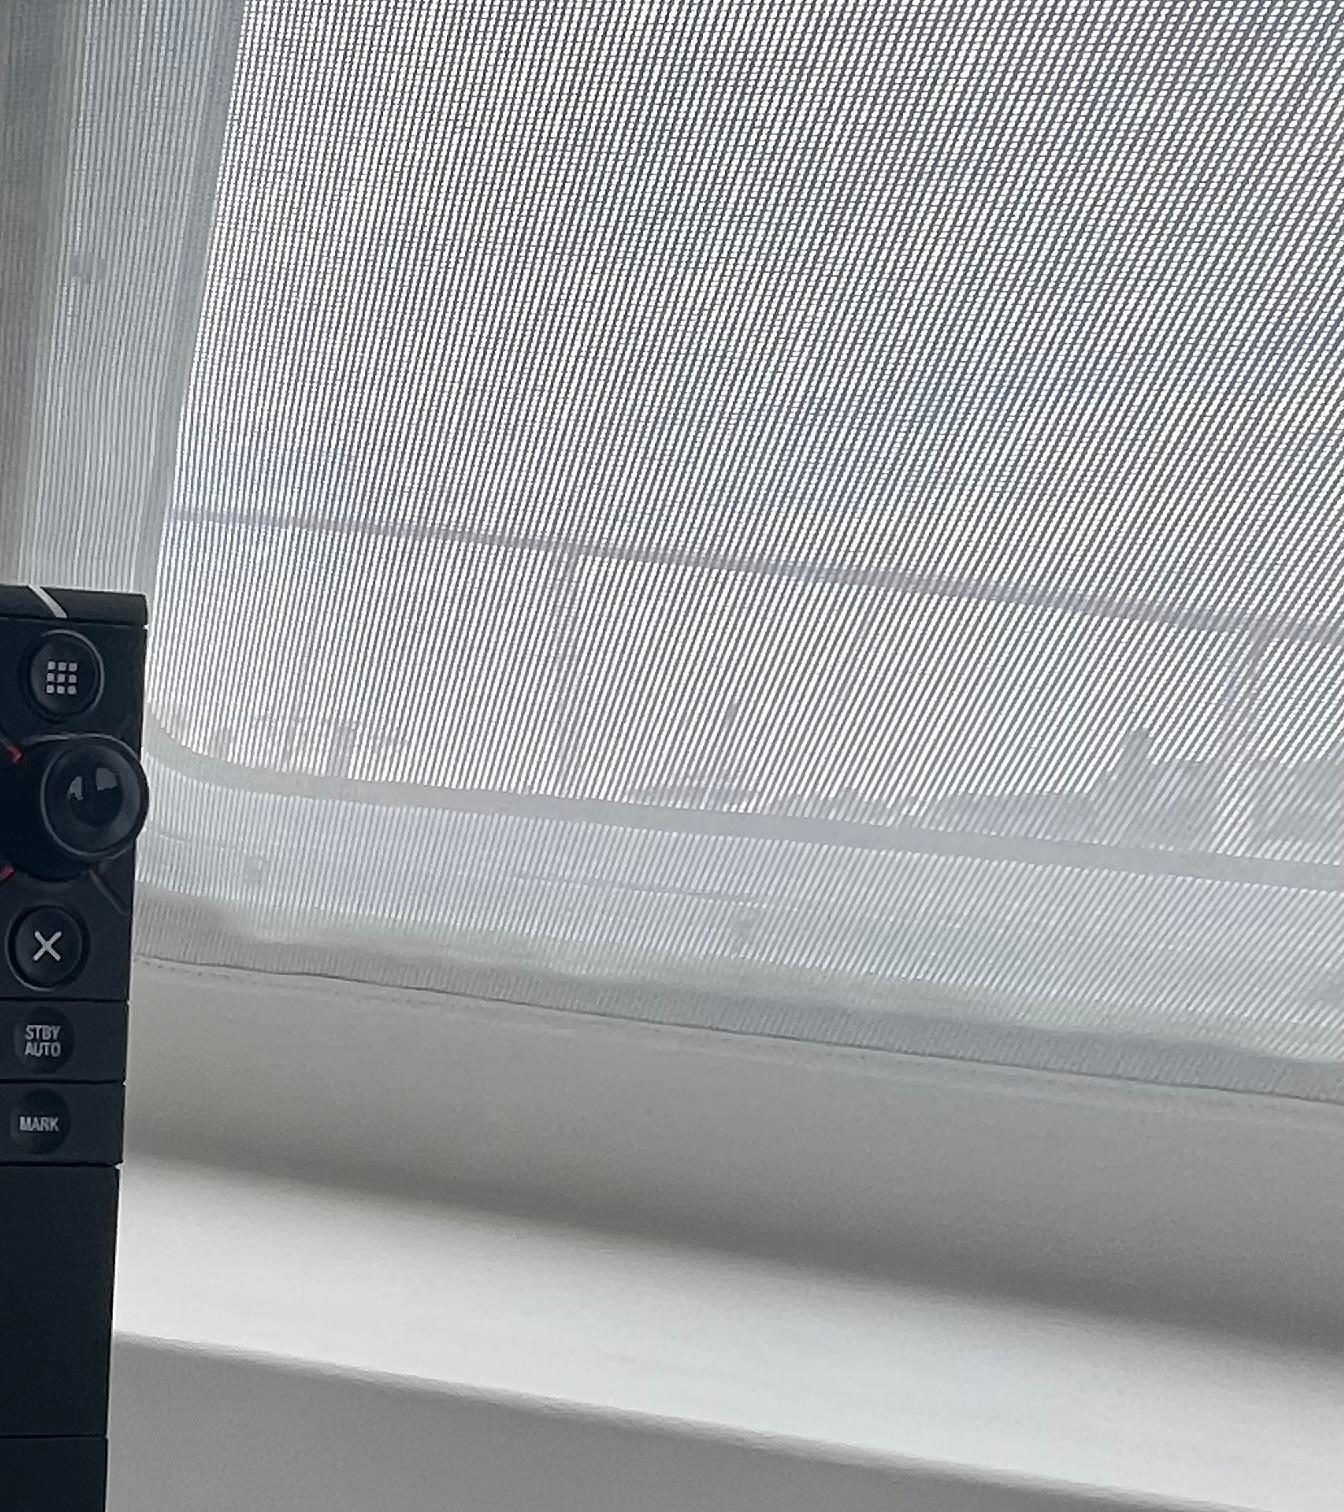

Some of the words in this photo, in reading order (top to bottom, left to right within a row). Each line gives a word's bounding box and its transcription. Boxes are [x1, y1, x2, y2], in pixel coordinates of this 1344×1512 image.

[25, 1024, 62, 1042] STBY
[24, 1041, 63, 1058] AUTO
[19, 1115, 59, 1132] MARK
